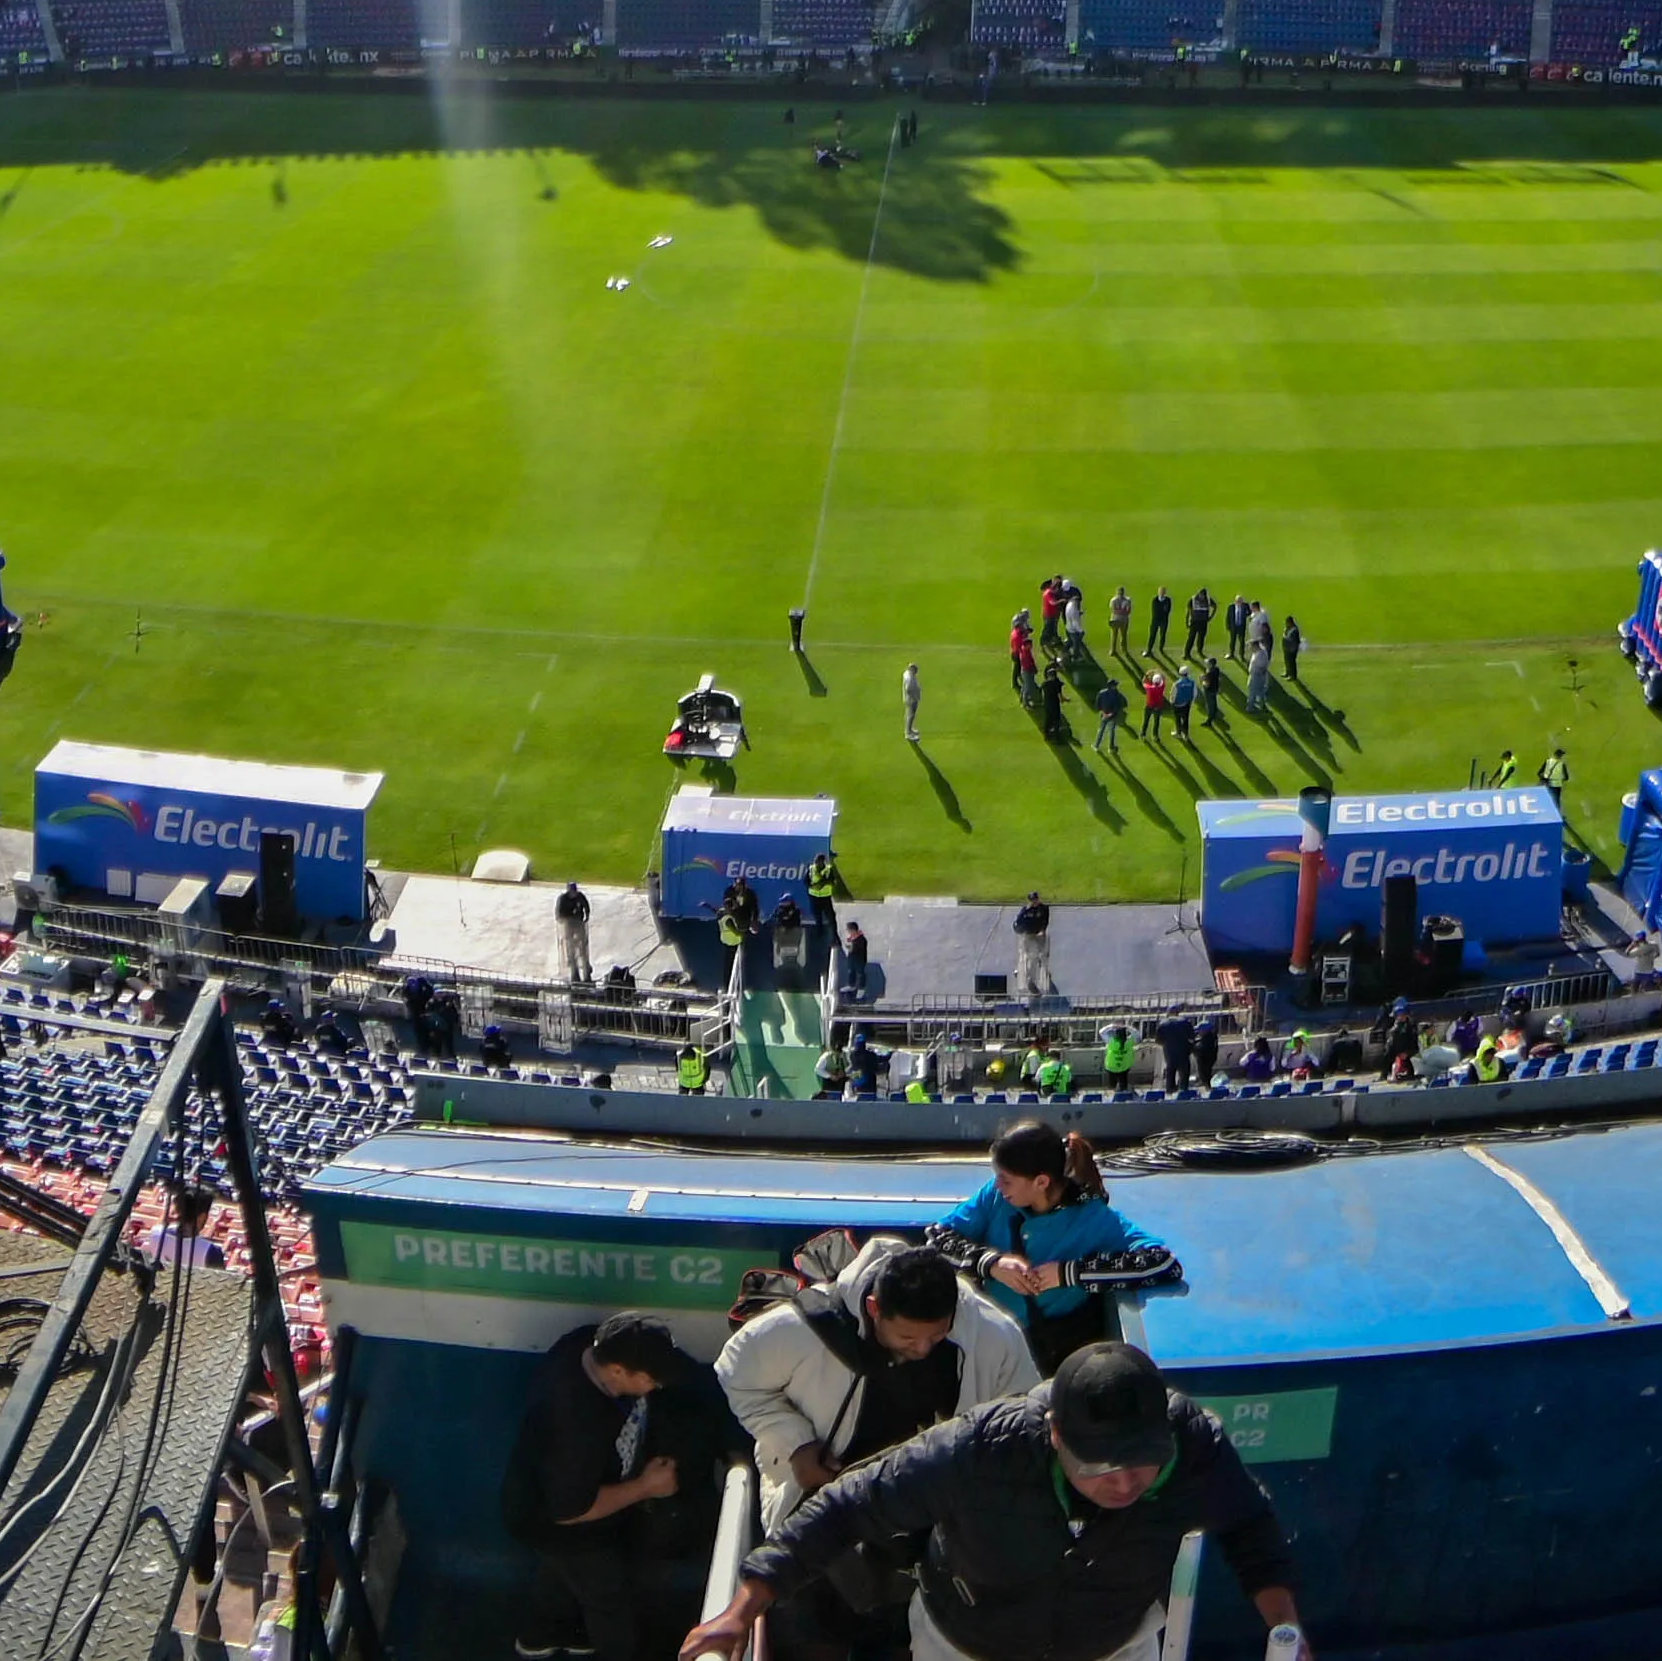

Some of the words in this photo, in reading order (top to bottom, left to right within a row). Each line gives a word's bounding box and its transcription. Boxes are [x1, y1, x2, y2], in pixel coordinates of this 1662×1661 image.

[728, 809, 823, 823] Electrolit
[1336, 794, 1540, 824] Electrolit
[726, 860, 808, 882] Electrol
[1342, 842, 1549, 889] Electrolit
[394, 1234, 657, 1282] PREFERENTE
[669, 1255, 723, 1285] C2
[1233, 1402, 1270, 1422] PR
[1231, 1429, 1266, 1447] C2
